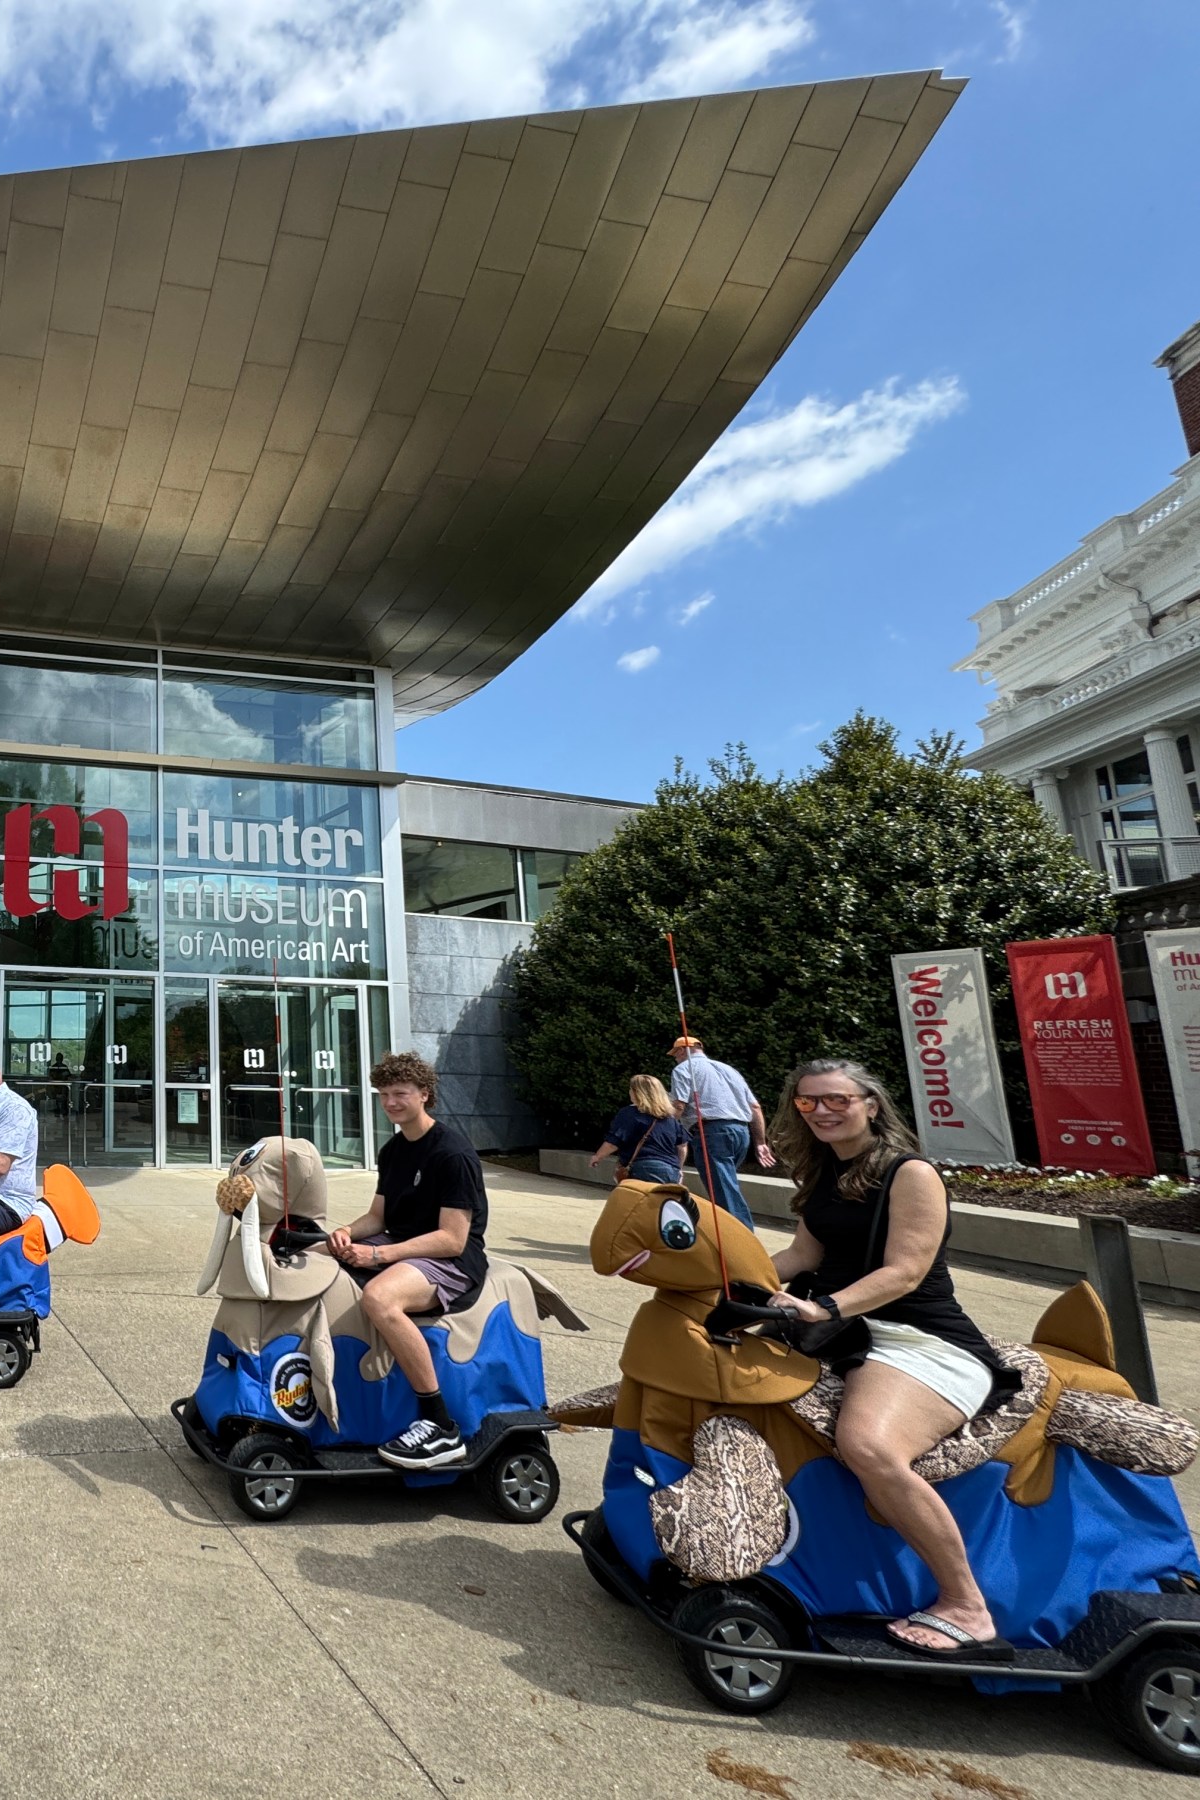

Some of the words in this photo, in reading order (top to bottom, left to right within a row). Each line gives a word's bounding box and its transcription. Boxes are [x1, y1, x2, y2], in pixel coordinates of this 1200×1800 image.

[176, 807, 364, 869] Hunter
[179, 931, 204, 956] of
[209, 933, 327, 962] American
[331, 937, 370, 964] Art
[1033, 1018, 1112, 1030] REFRESH
[1034, 1029, 1073, 1039] YOUR
[1077, 1028, 1114, 1038] VIEW
[907, 965, 965, 1129] Welcome!
